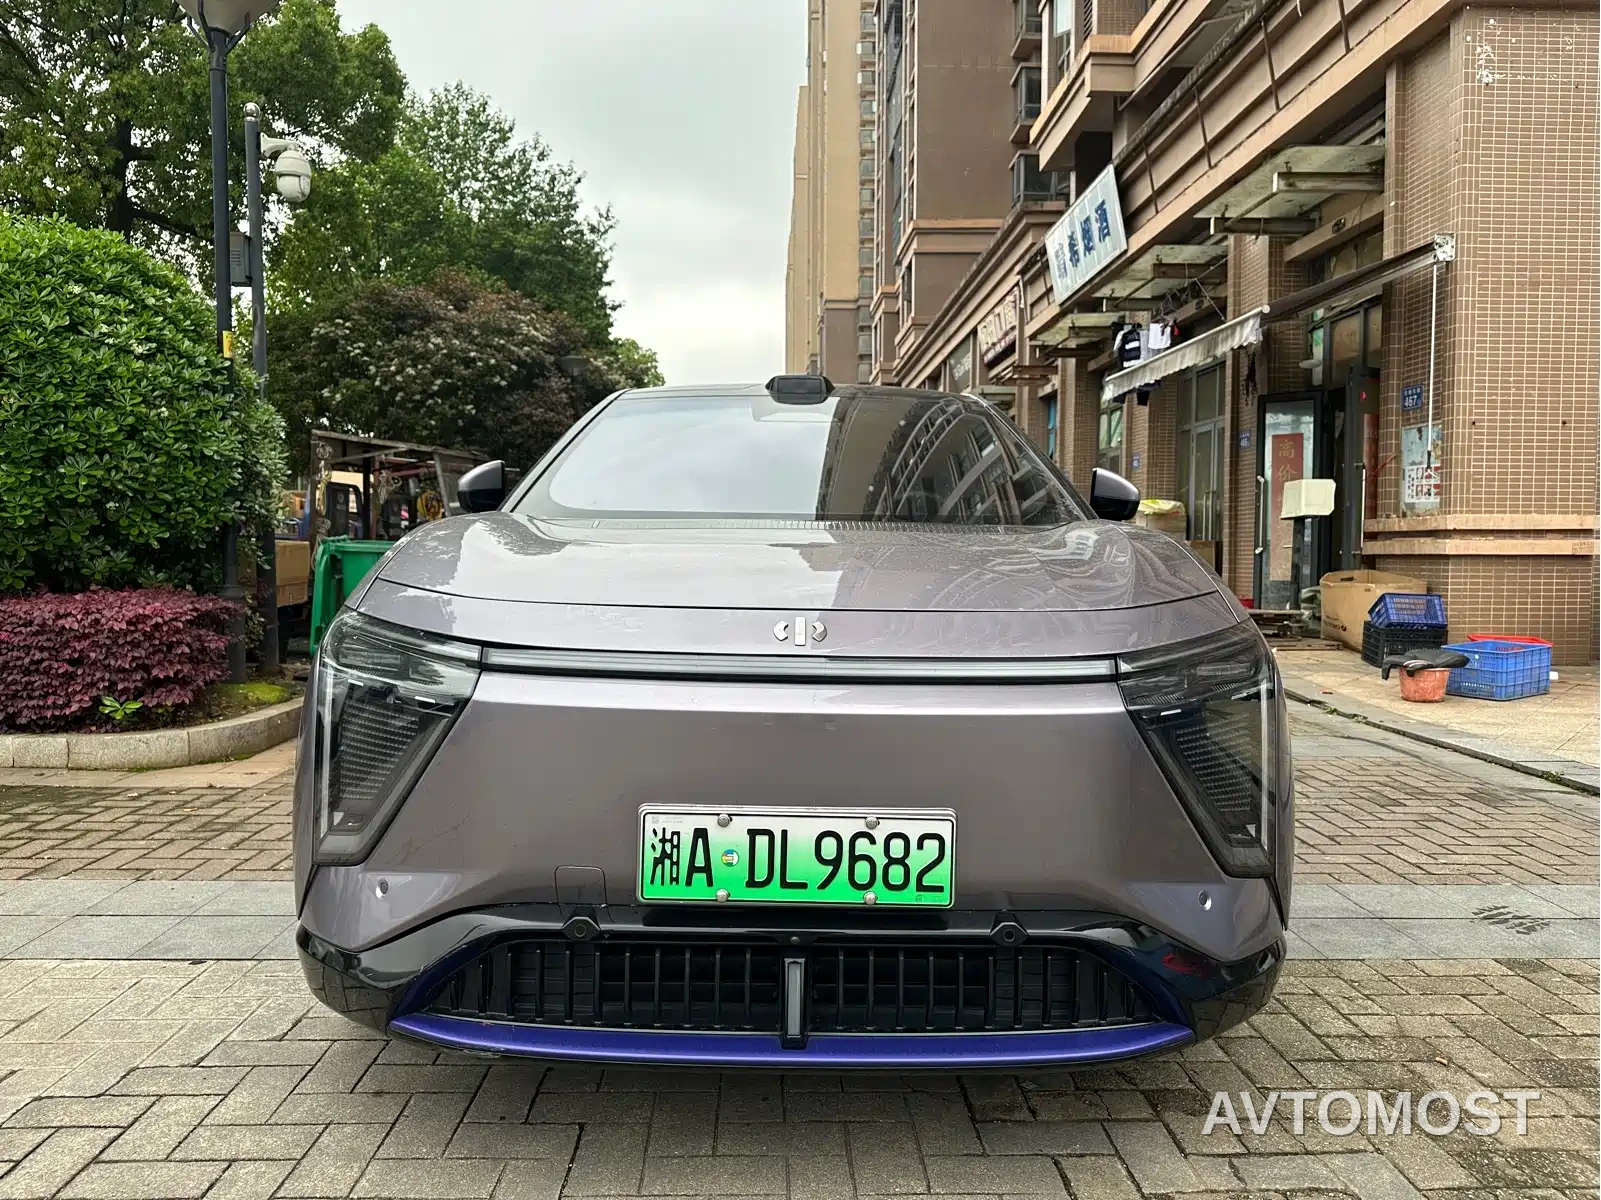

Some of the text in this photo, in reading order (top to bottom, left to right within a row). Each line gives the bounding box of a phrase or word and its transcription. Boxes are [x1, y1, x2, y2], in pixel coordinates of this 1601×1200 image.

[1404, 395, 1418, 407] 467
[649, 826, 946, 893] 湘A DL9682
